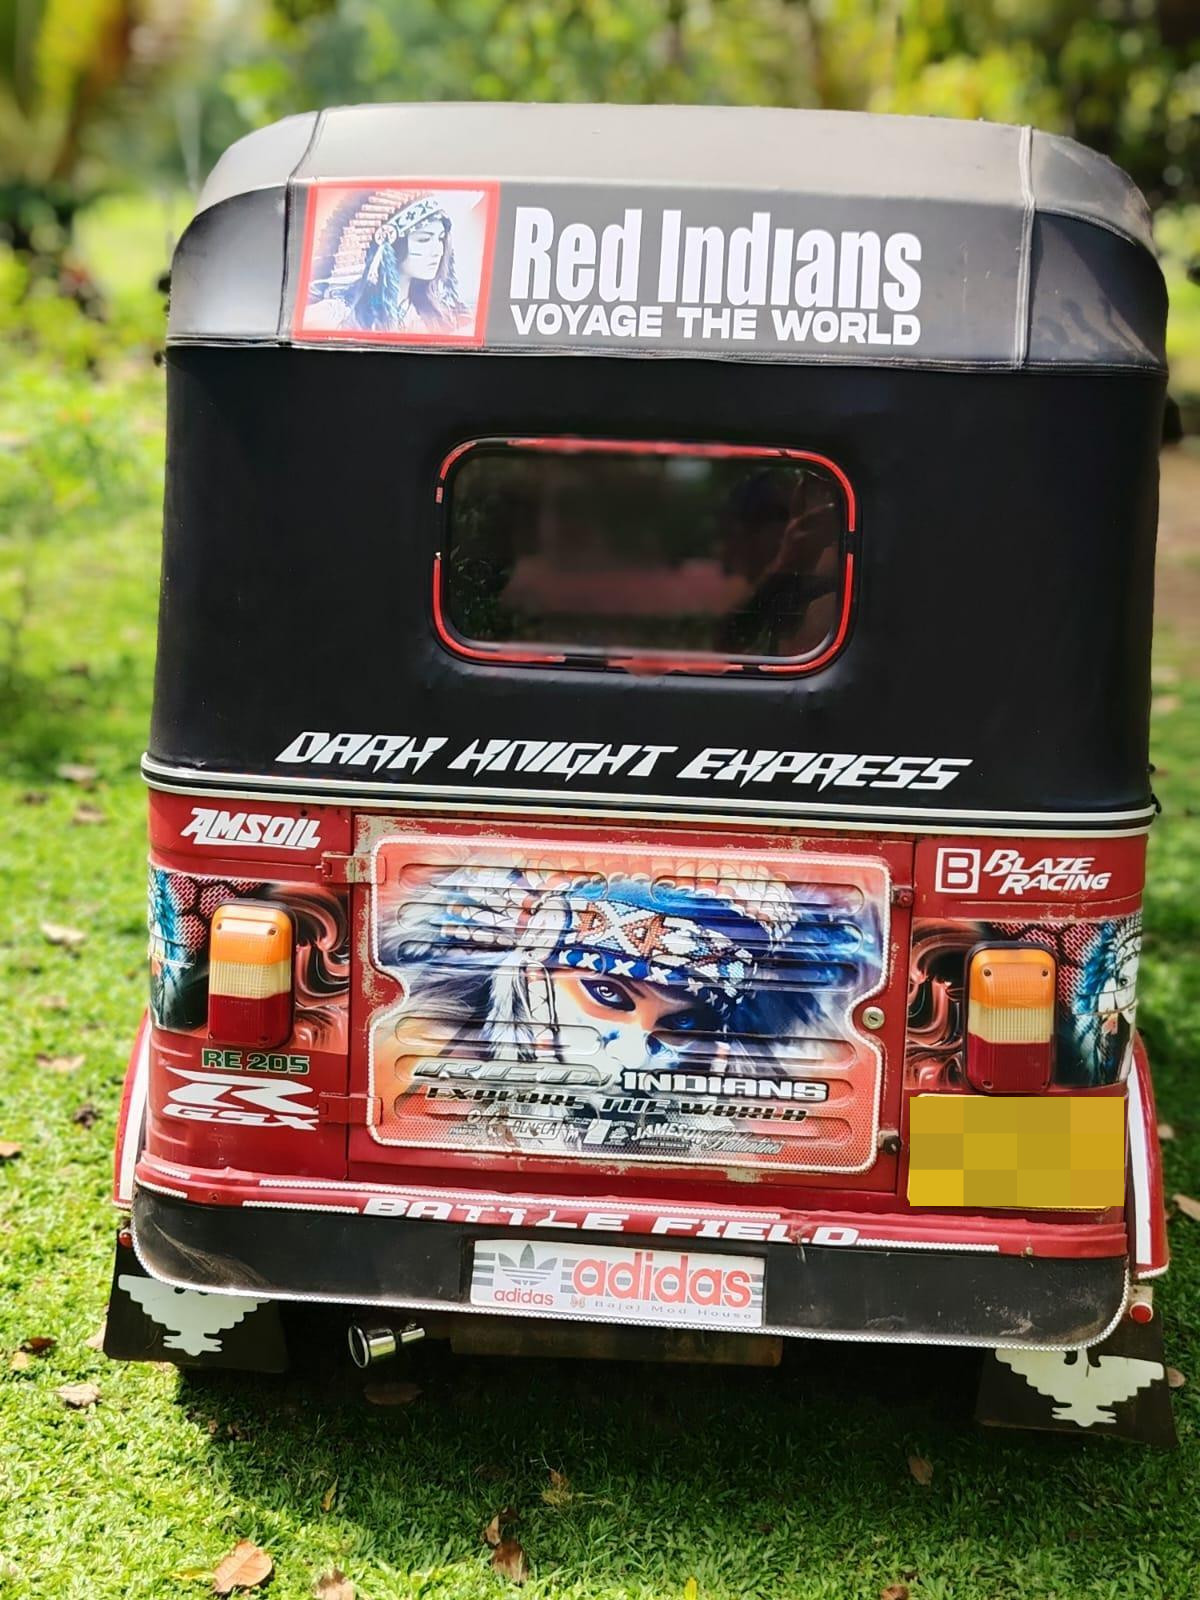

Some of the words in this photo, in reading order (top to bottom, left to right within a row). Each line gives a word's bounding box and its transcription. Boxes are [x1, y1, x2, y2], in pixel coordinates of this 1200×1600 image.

[509, 206, 643, 303] Red
[658, 208, 922, 312] Indians
[509, 304, 663, 338] VOYAGE
[675, 306, 757, 341] THE
[770, 308, 921, 346] WORLD
[274, 731, 448, 773] DARK
[447, 738, 679, 780] KNIGHT
[676, 747, 974, 792] EXPRESS
[181, 807, 321, 850] AMSOIL
[983, 849, 1095, 877] BLAZE
[999, 872, 1112, 895] RACING
[202, 1048, 242, 1070] RE
[246, 1051, 310, 1075] 205
[621, 1070, 828, 1102] INDIANS
[600, 1097, 671, 1117] THE
[680, 1101, 808, 1122] WORLD
[363, 1197, 630, 1232] BATTLE
[651, 1216, 859, 1246] FIELD
[572, 1251, 752, 1309] adidas
[494, 1288, 553, 1306] adidas
[651, 1306, 688, 1315] Mod
